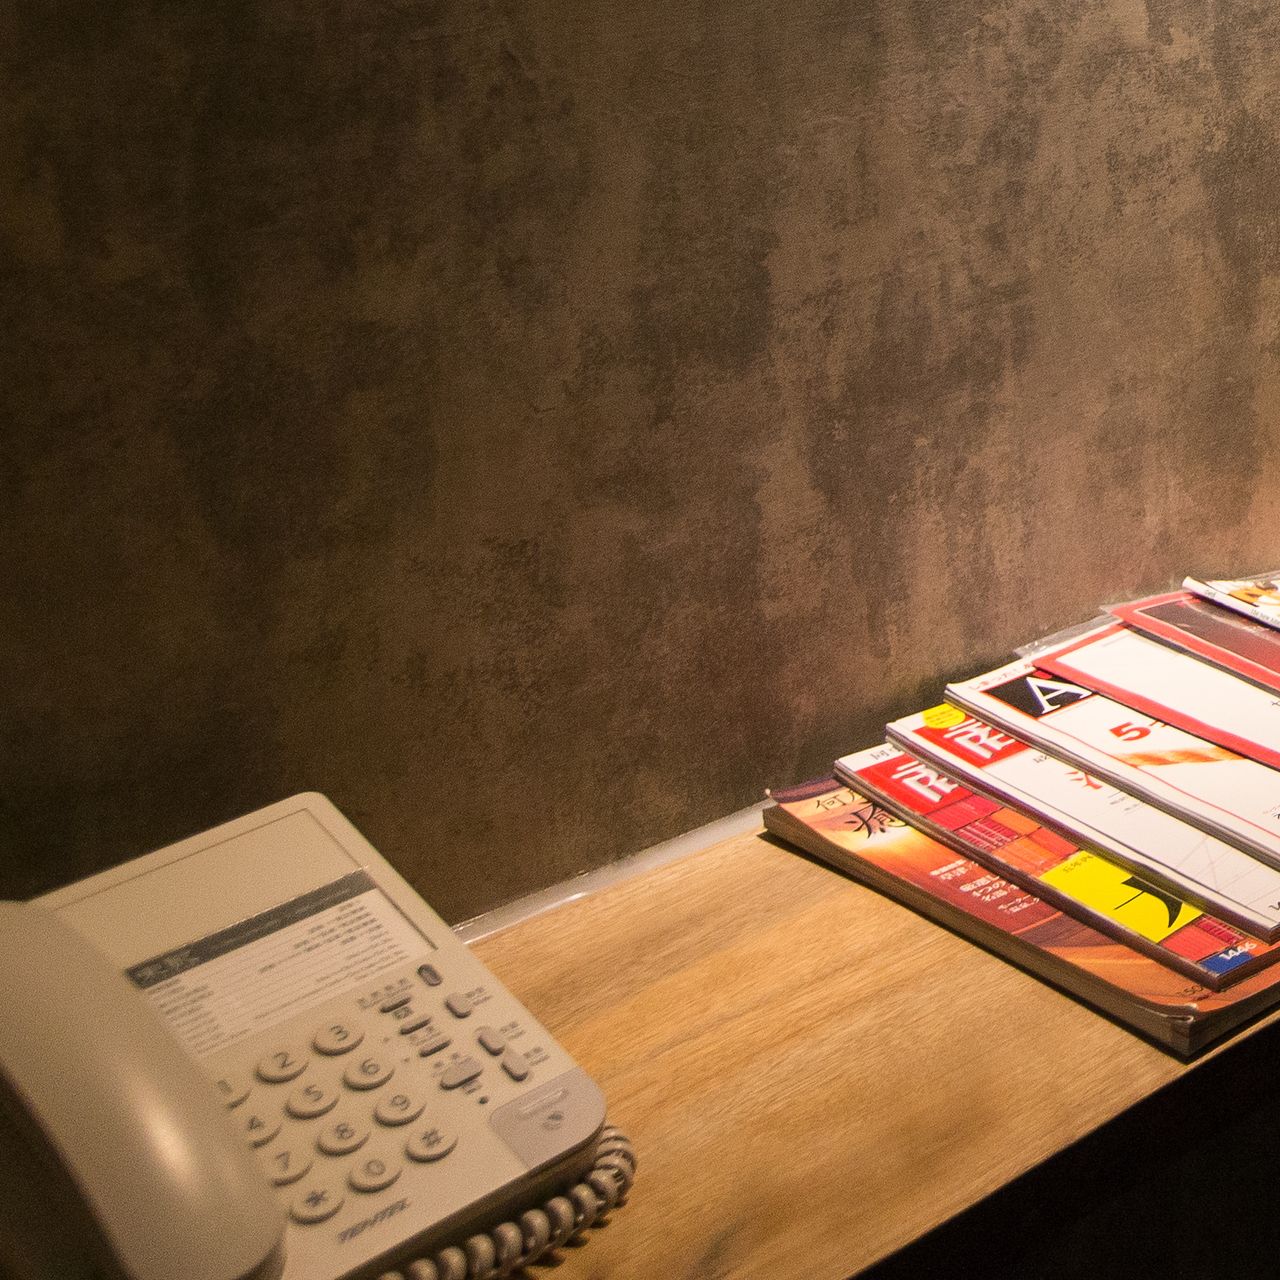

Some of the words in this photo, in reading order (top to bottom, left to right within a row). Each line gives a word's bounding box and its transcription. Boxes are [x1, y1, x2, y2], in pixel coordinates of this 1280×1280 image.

[1219, 940, 1258, 960] 1446
[329, 1024, 349, 1042] 3
[274, 1051, 294, 1069] 2
